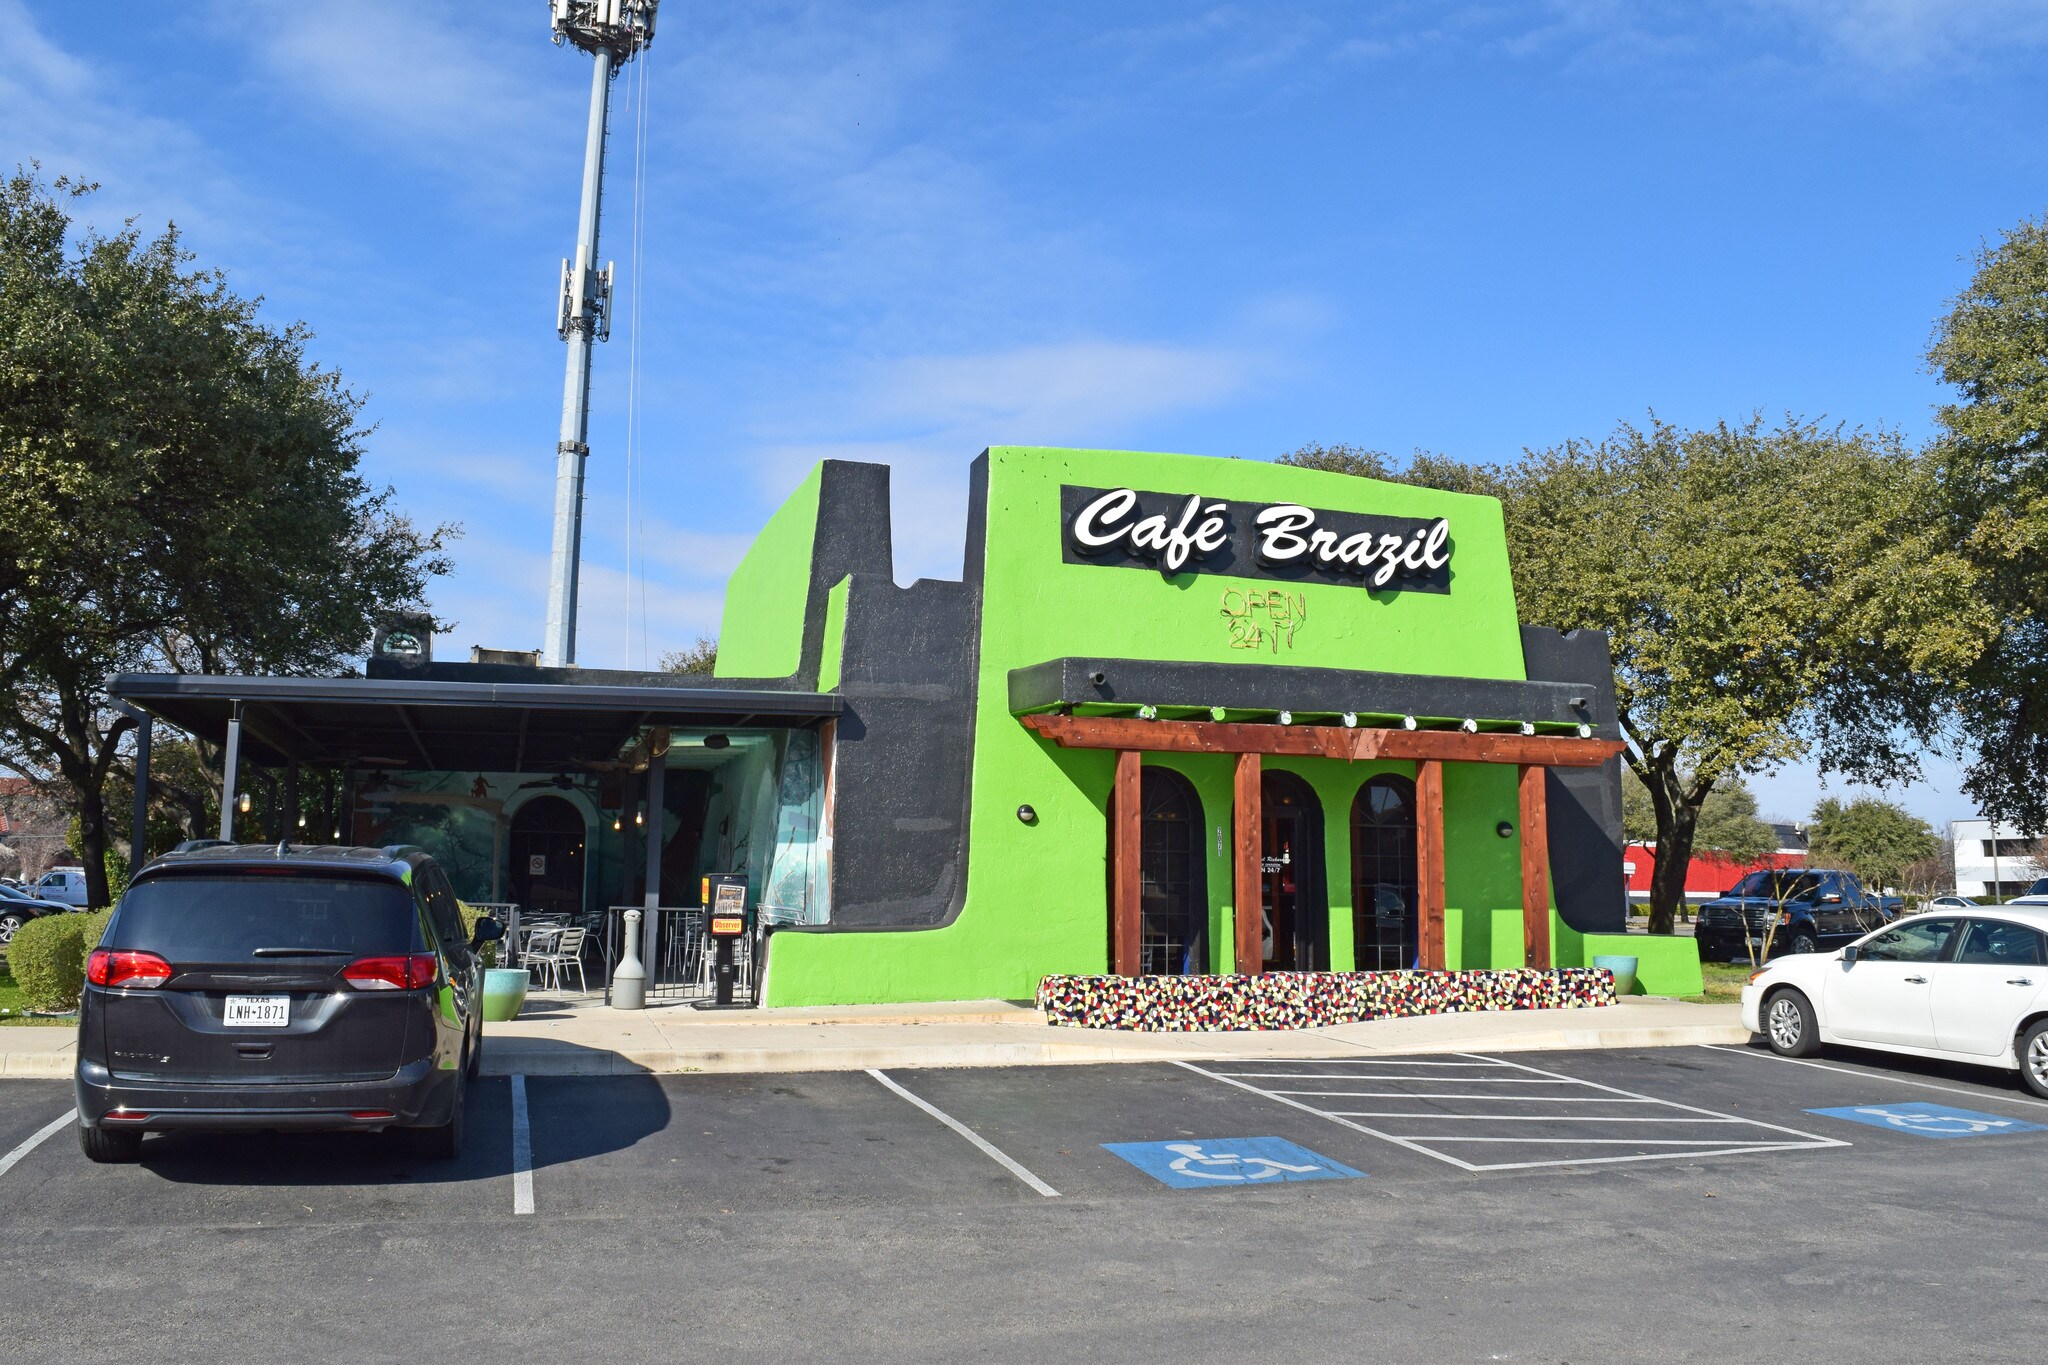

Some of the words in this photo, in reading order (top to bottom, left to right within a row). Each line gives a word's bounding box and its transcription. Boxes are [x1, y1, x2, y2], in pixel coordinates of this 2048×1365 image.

[1075, 488, 1227, 570] Café
[1256, 505, 1450, 586] Brazil
[1222, 588, 1306, 620] OPEN
[714, 920, 740, 929] Observer
